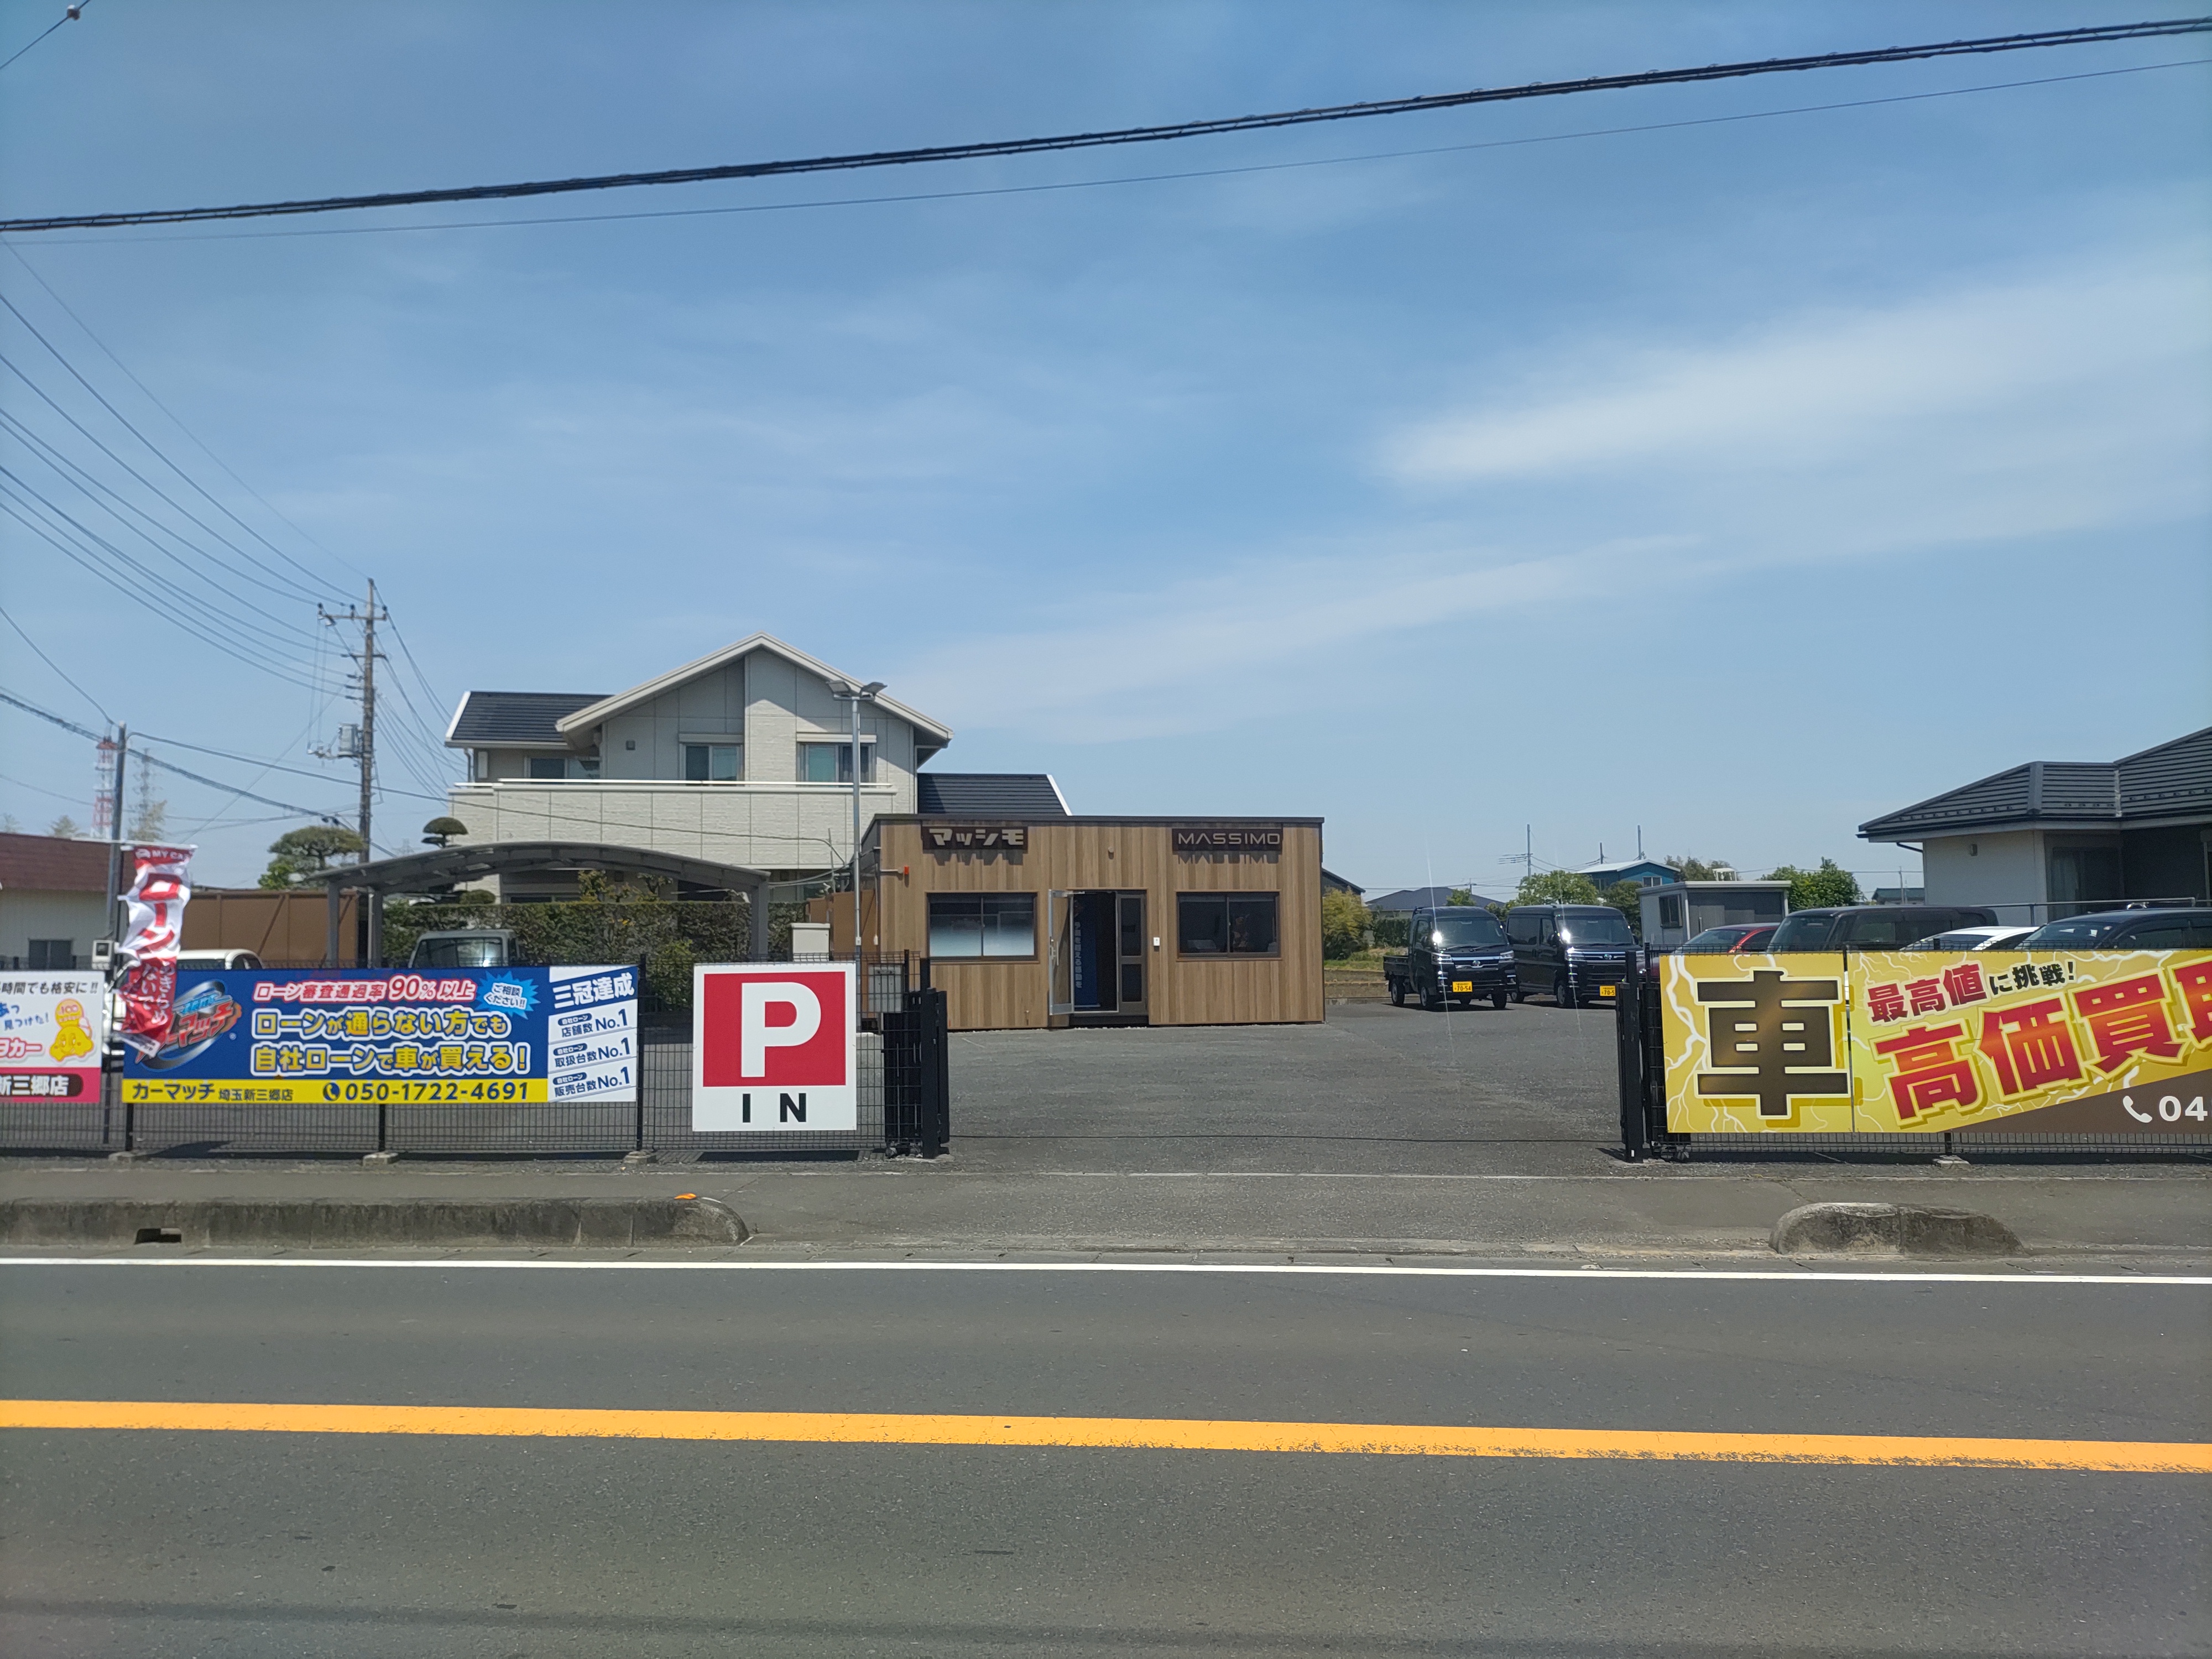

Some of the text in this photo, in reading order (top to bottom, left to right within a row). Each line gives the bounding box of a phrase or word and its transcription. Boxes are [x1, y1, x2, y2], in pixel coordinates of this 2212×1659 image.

[929, 828, 1024, 846] マッシモ
[1178, 832, 1281, 845] MASSIMO
[0, 982, 98, 994] 時間でも格安に!!
[552, 972, 635, 1009] 三冠達成
[1867, 961, 2075, 1022] 最高値に挑戦!
[254, 1007, 509, 1038] ローンが通らない方でも
[595, 1009, 628, 1031] No.1
[741, 982, 821, 1077] P
[598, 1037, 630, 1060] No.1
[1697, 969, 1849, 1117] 車
[254, 1044, 528, 1073] 自社ローンで車が買える!
[597, 1066, 630, 1090] No.1
[133, 1083, 214, 1100] カーマッチ
[345, 1082, 528, 1101] 050-1722-4691
[2159, 1095, 2212, 1121] 04
